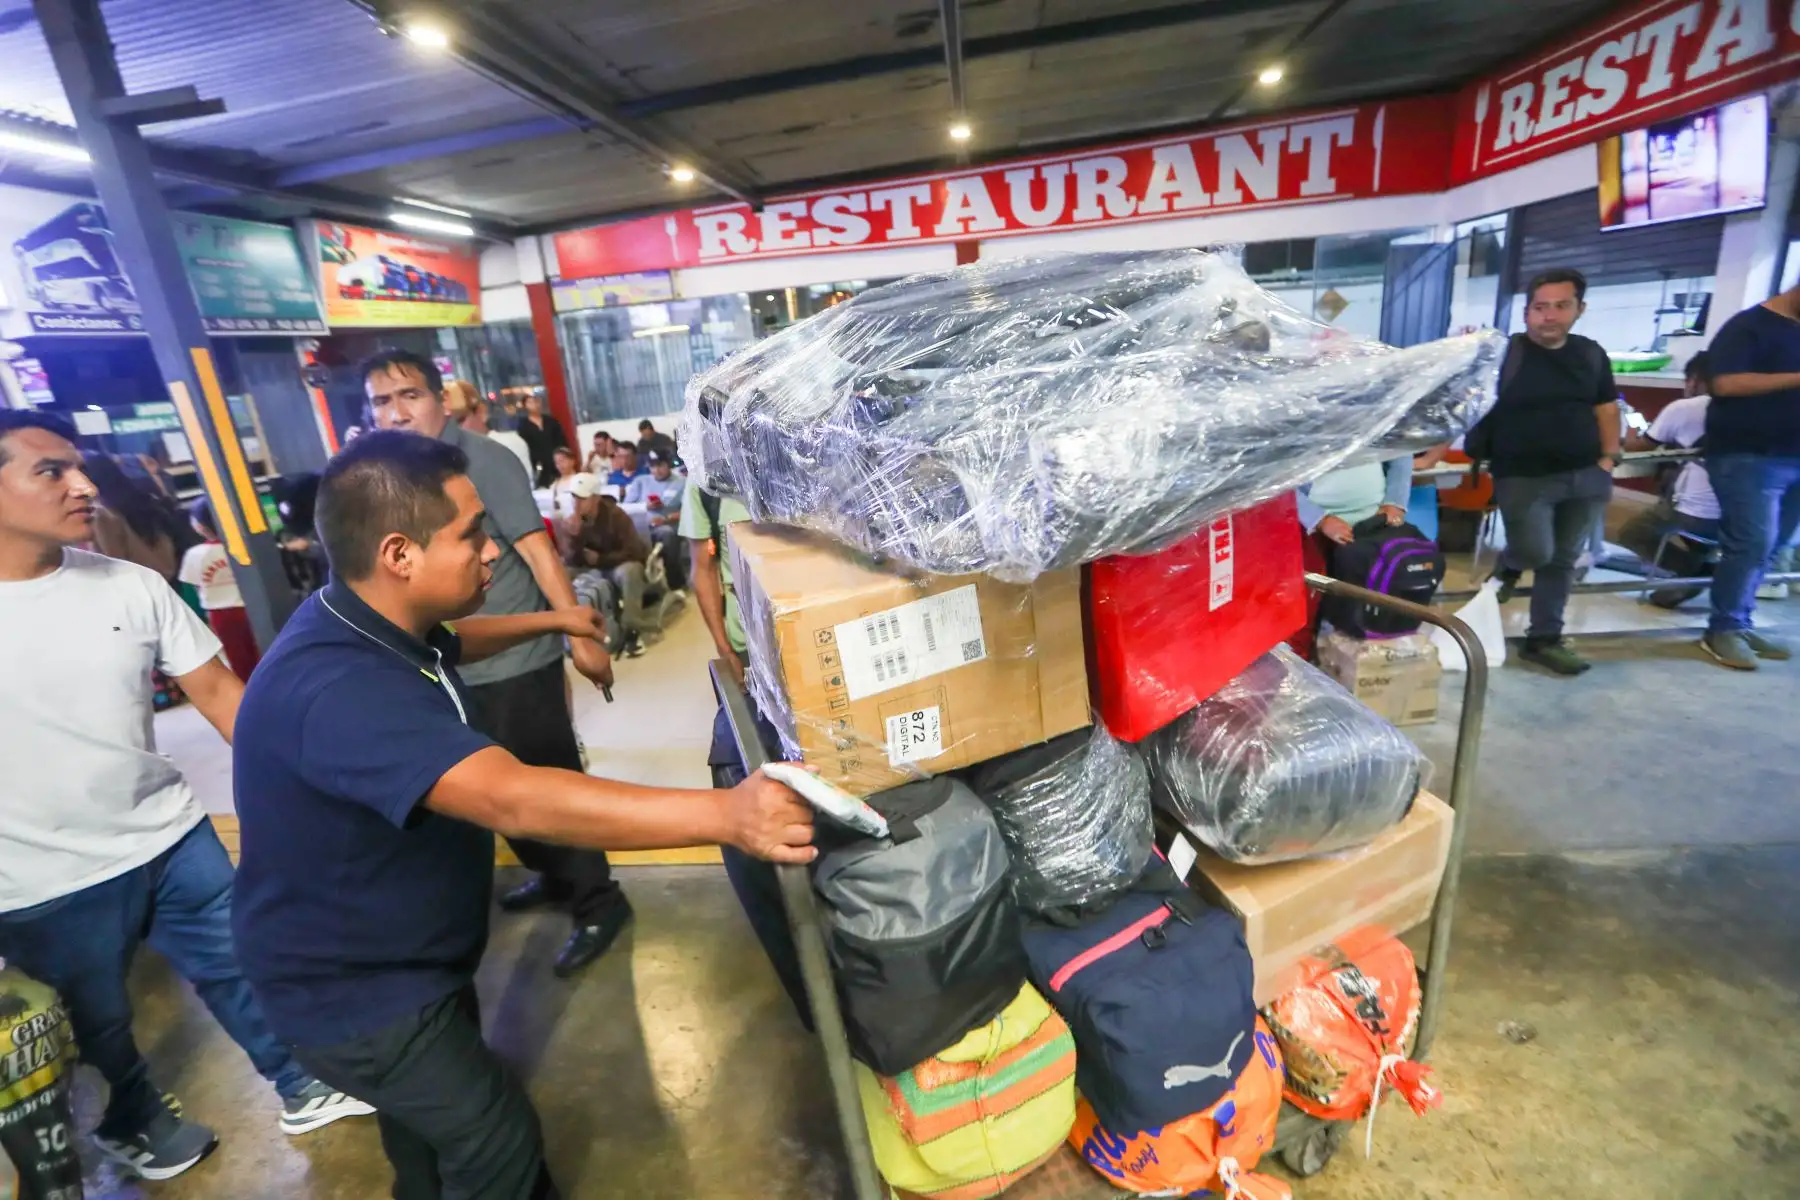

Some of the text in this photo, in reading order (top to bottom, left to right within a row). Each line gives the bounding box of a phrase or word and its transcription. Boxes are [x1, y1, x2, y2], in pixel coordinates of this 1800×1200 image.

[1494, 0, 1800, 151] RESTA
[693, 115, 1355, 258] RESTAURANT
[899, 716, 910, 757] DIGITAL
[912, 711, 926, 744] 872
